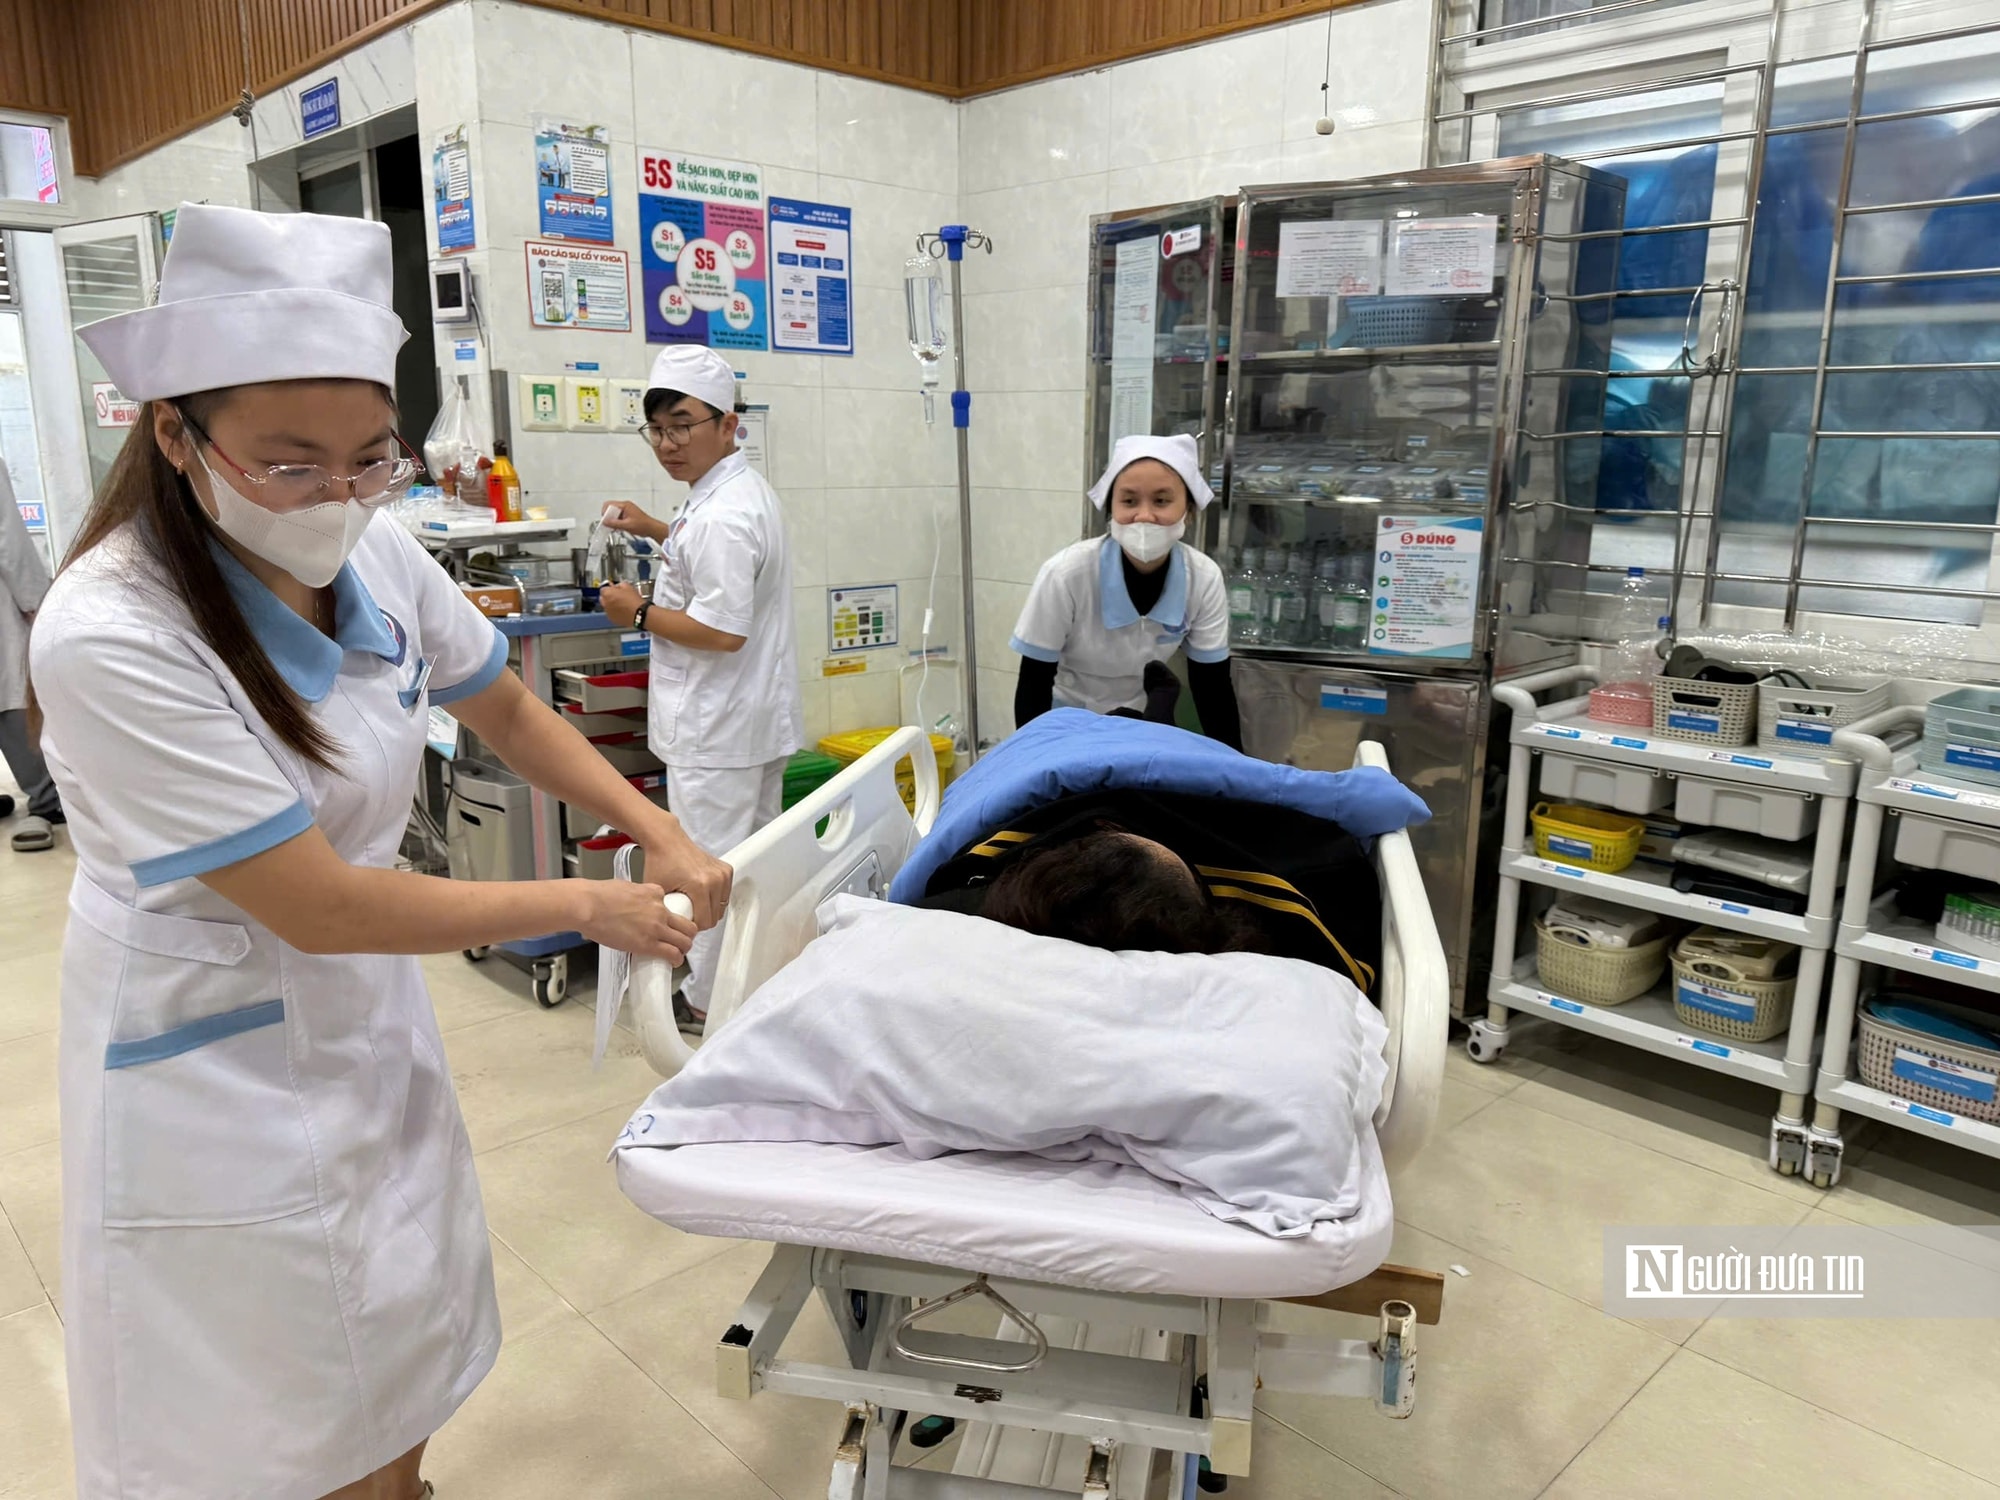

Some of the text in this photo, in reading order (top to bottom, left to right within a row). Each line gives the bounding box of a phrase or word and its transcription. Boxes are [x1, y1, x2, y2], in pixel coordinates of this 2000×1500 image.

[643, 156, 673, 189] 5S
[728, 187, 743, 199] CAO
[661, 229, 674, 241] S1
[735, 238, 748, 250] S2
[531, 247, 550, 257] BÁO
[600, 255, 623, 264] KHOA
[694, 247, 716, 271] S5
[669, 294, 682, 306] S4
[733, 300, 746, 312] S3
[1416, 531, 1456, 545] ĐÚNG
